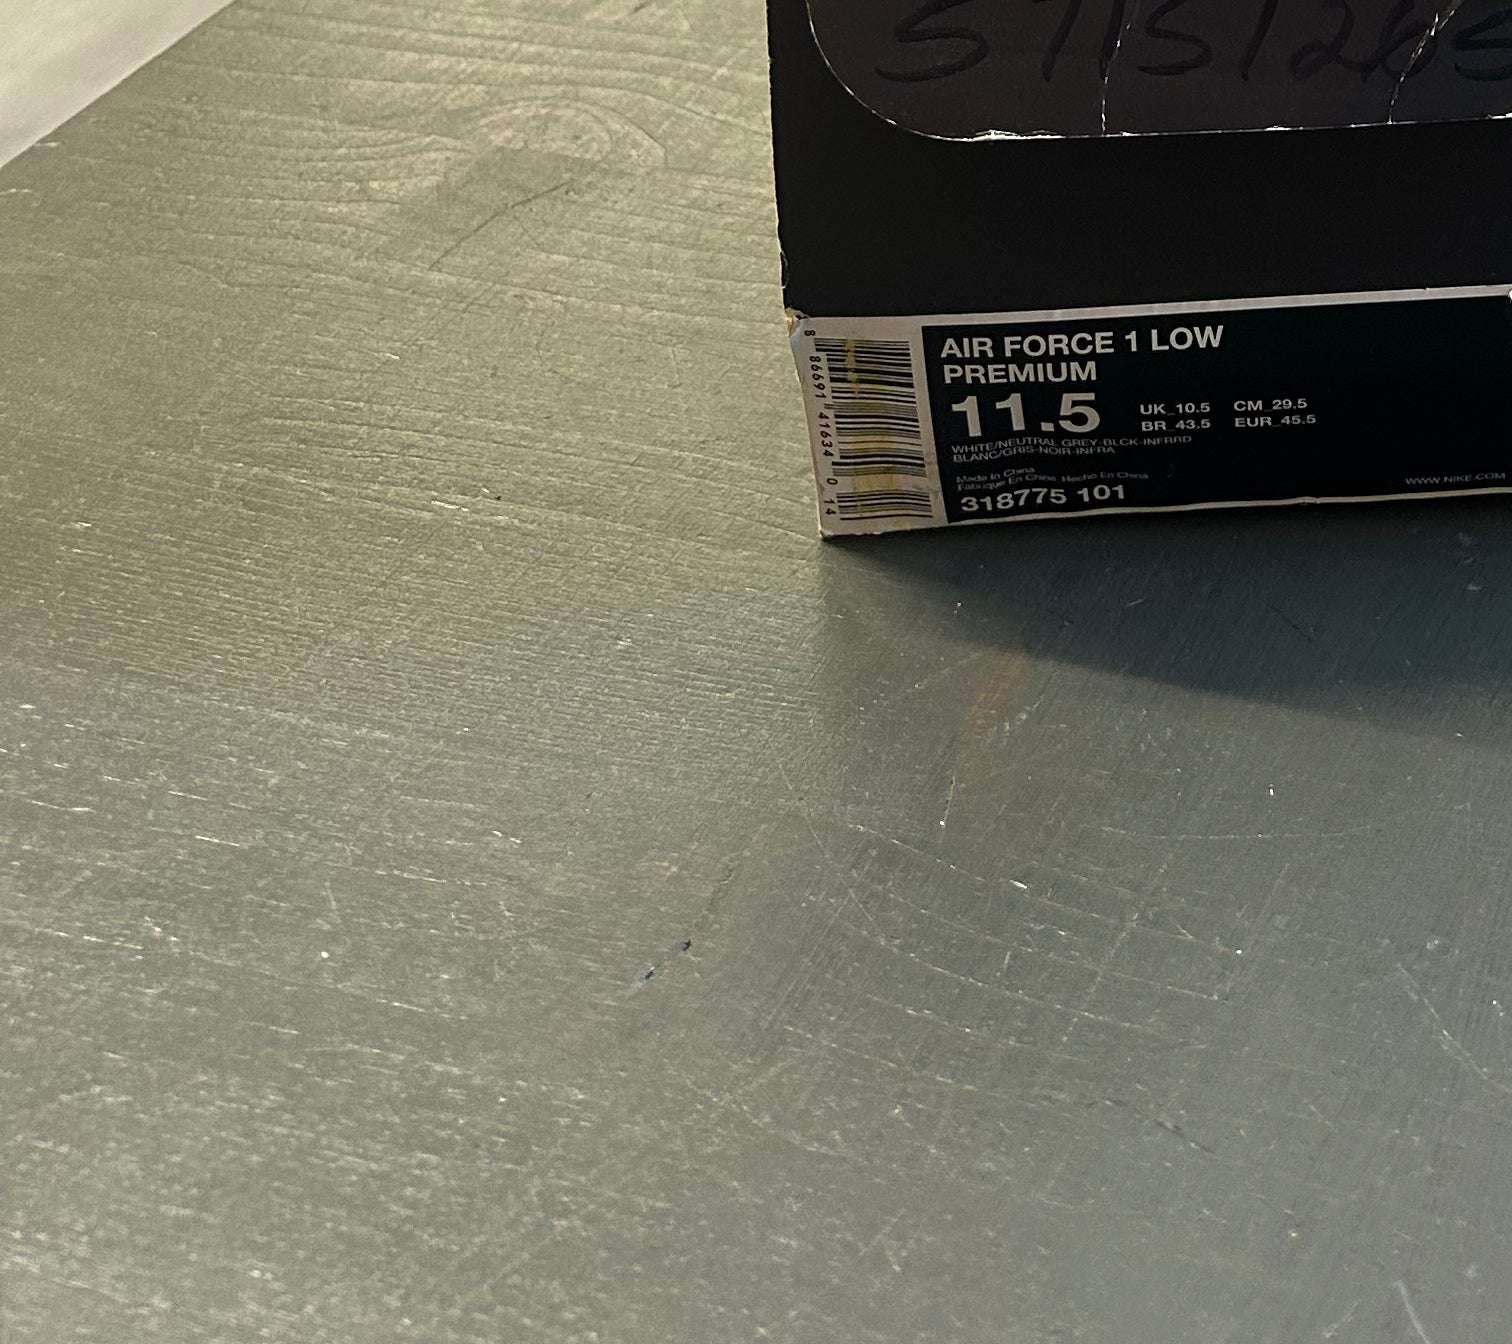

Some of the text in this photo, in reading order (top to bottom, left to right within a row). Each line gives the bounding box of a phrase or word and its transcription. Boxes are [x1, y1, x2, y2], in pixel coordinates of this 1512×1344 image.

[941, 324, 1225, 359] AIR FORCE 1 LOW
[943, 360, 1098, 385] PREMIUM
[809, 355, 827, 400] 86691
[818, 411, 834, 457] 41634
[951, 391, 1102, 438] 11.5
[960, 484, 1125, 512] 318775 101
